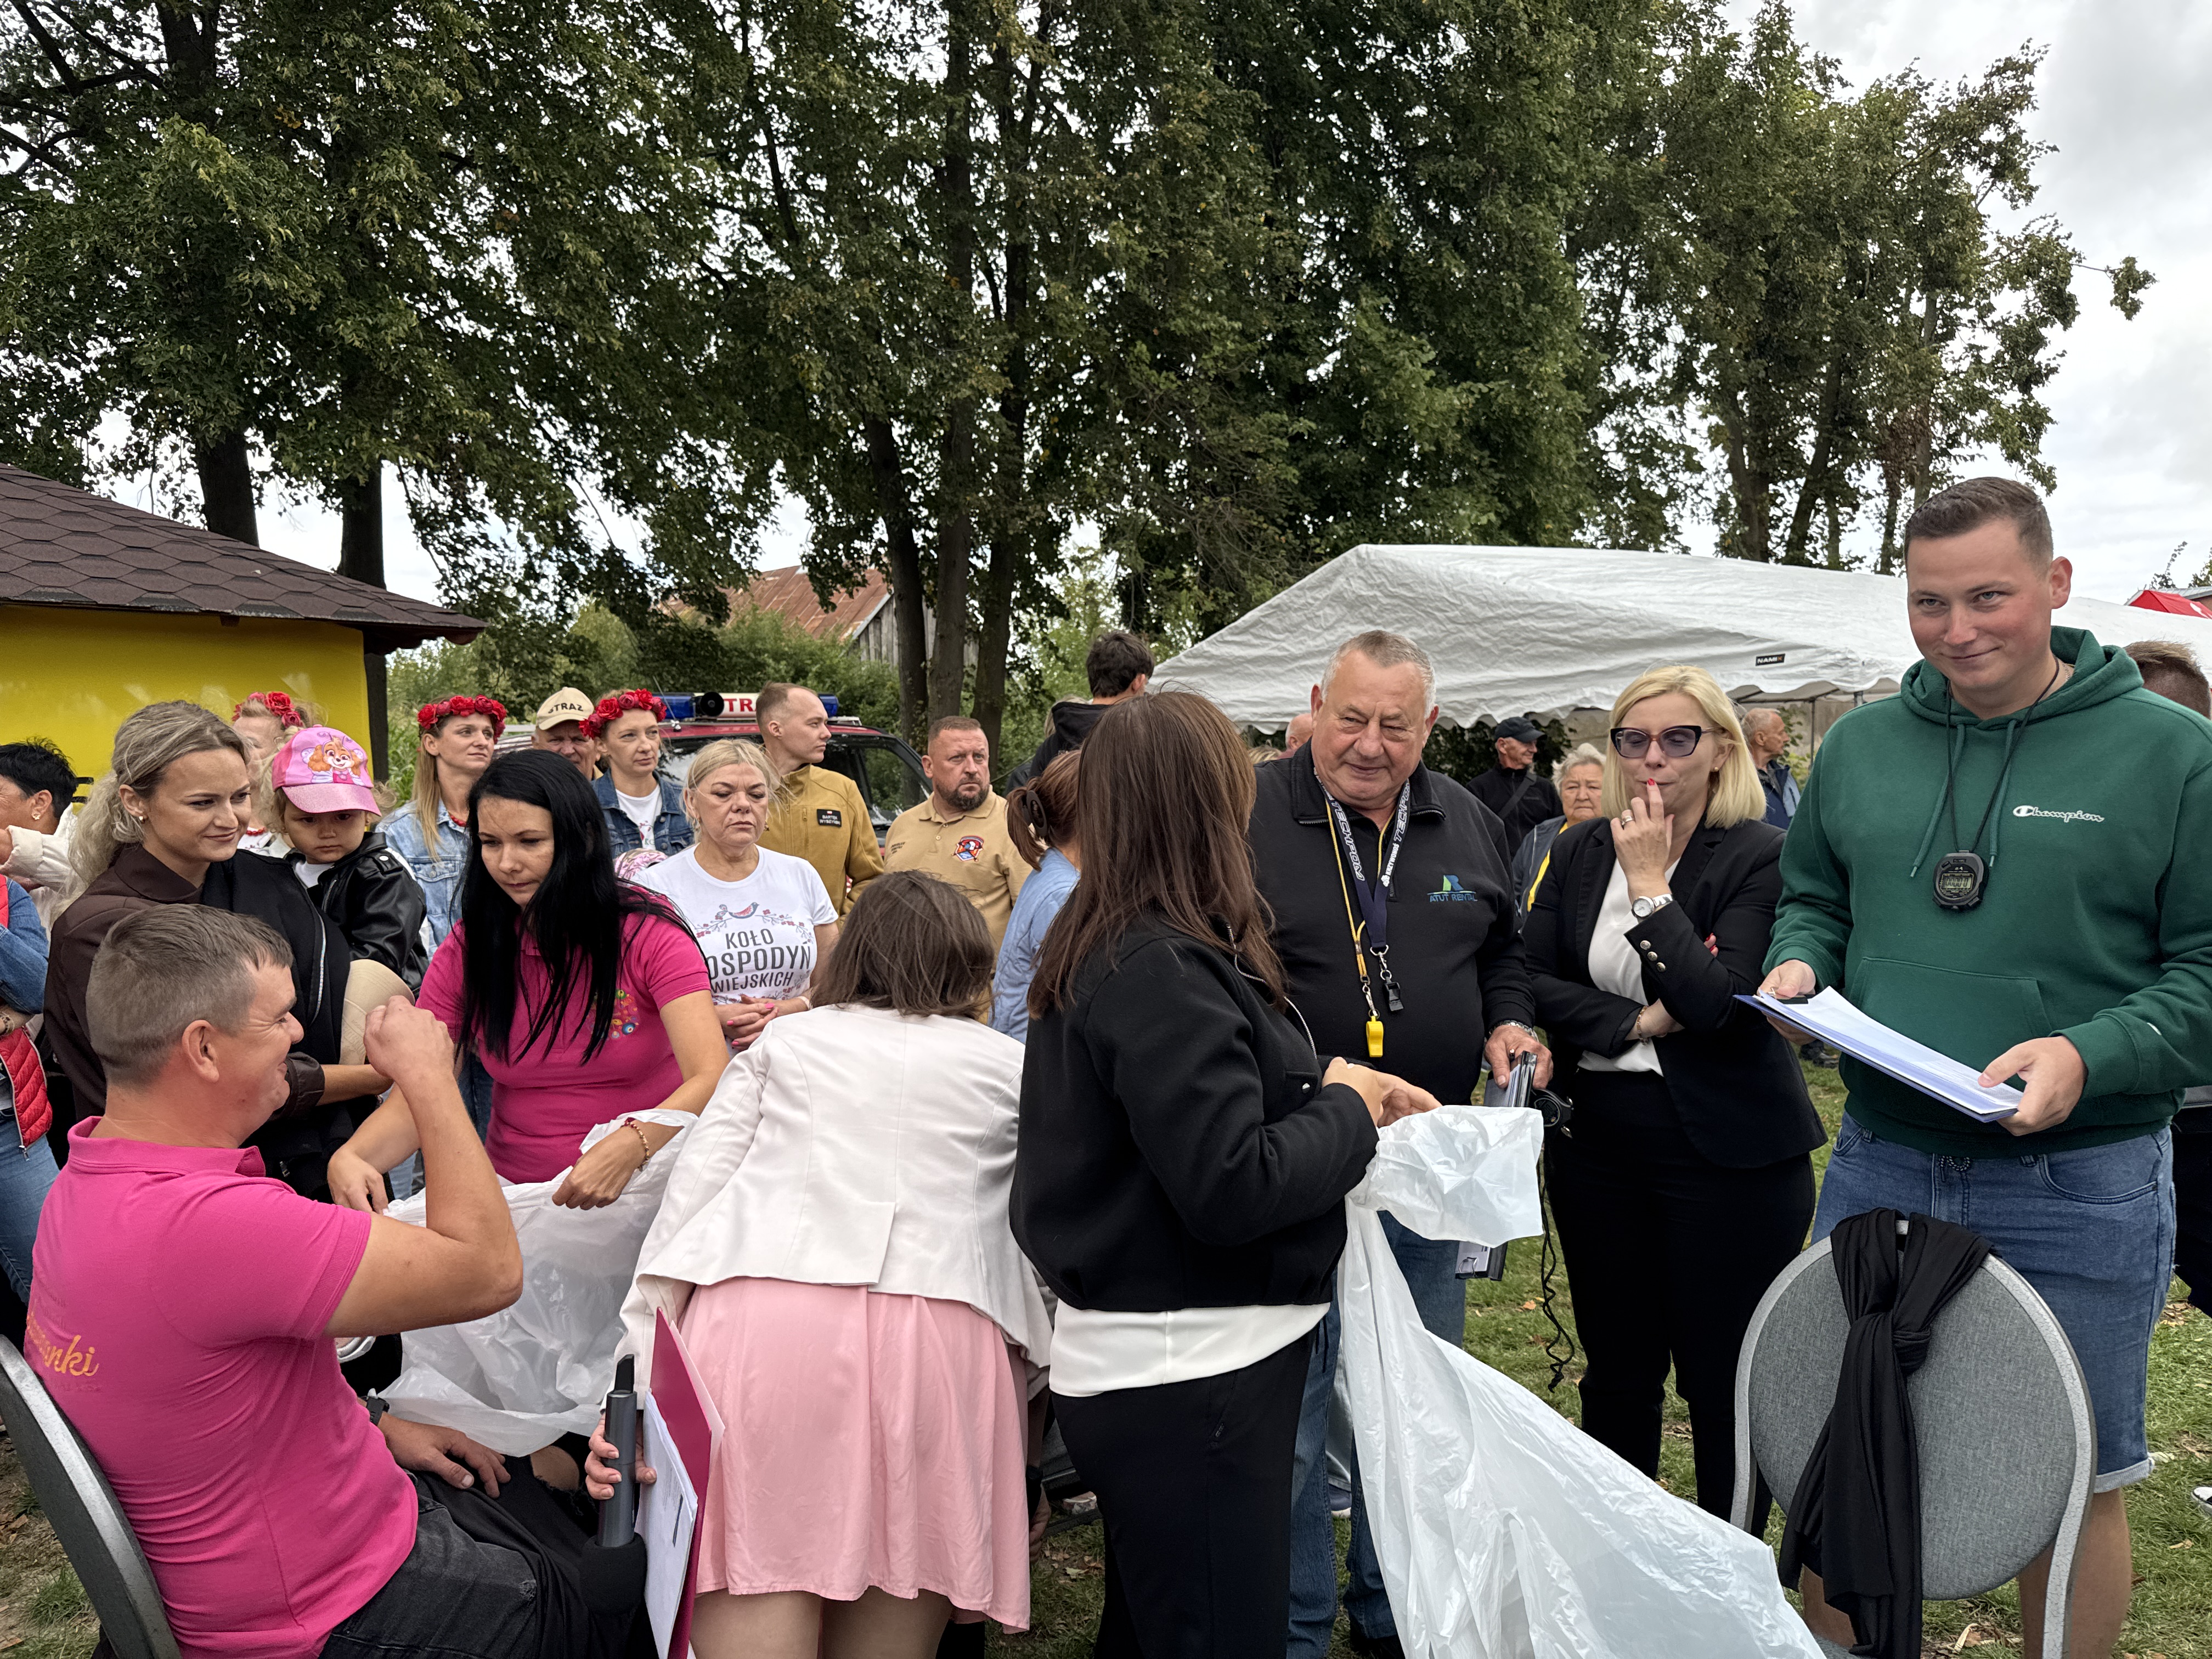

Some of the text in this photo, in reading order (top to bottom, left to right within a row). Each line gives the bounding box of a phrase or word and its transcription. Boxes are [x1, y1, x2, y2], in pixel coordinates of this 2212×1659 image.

[723, 698, 757, 712] TR
[2013, 805, 2105, 823] Champion
[1430, 893, 1478, 902] ATUT RENTAL
[725, 928, 774, 950] KOŁO
[707, 941, 810, 980] OSPODYŃ
[712, 972, 794, 994] WIEJSKICH
